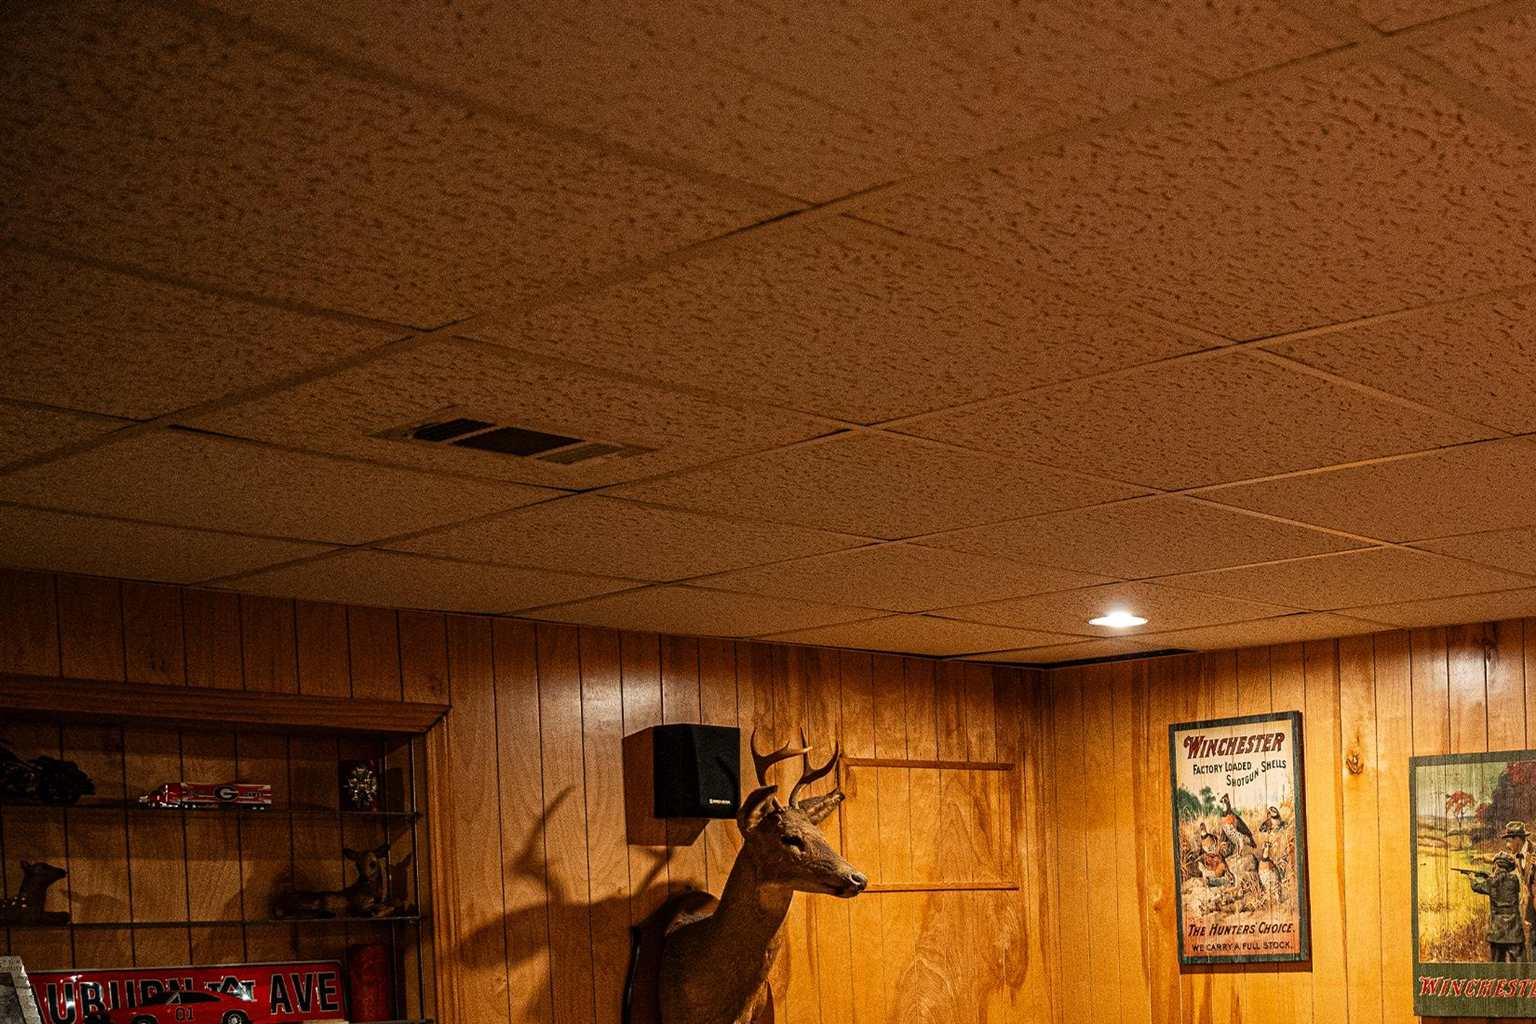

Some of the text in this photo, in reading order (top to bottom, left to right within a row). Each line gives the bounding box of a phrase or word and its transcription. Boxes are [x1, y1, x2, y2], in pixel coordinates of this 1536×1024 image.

[1184, 732, 1285, 760] WINCHESTER
[1193, 761, 1252, 775] FACTORY LOADED
[1226, 760, 1287, 787] SHOTGUN SHELLS
[1188, 924, 1206, 936] THE
[1206, 943, 1234, 951] CARRY
[1243, 942, 1261, 950] FULL
[270, 971, 340, 1016] AVE
